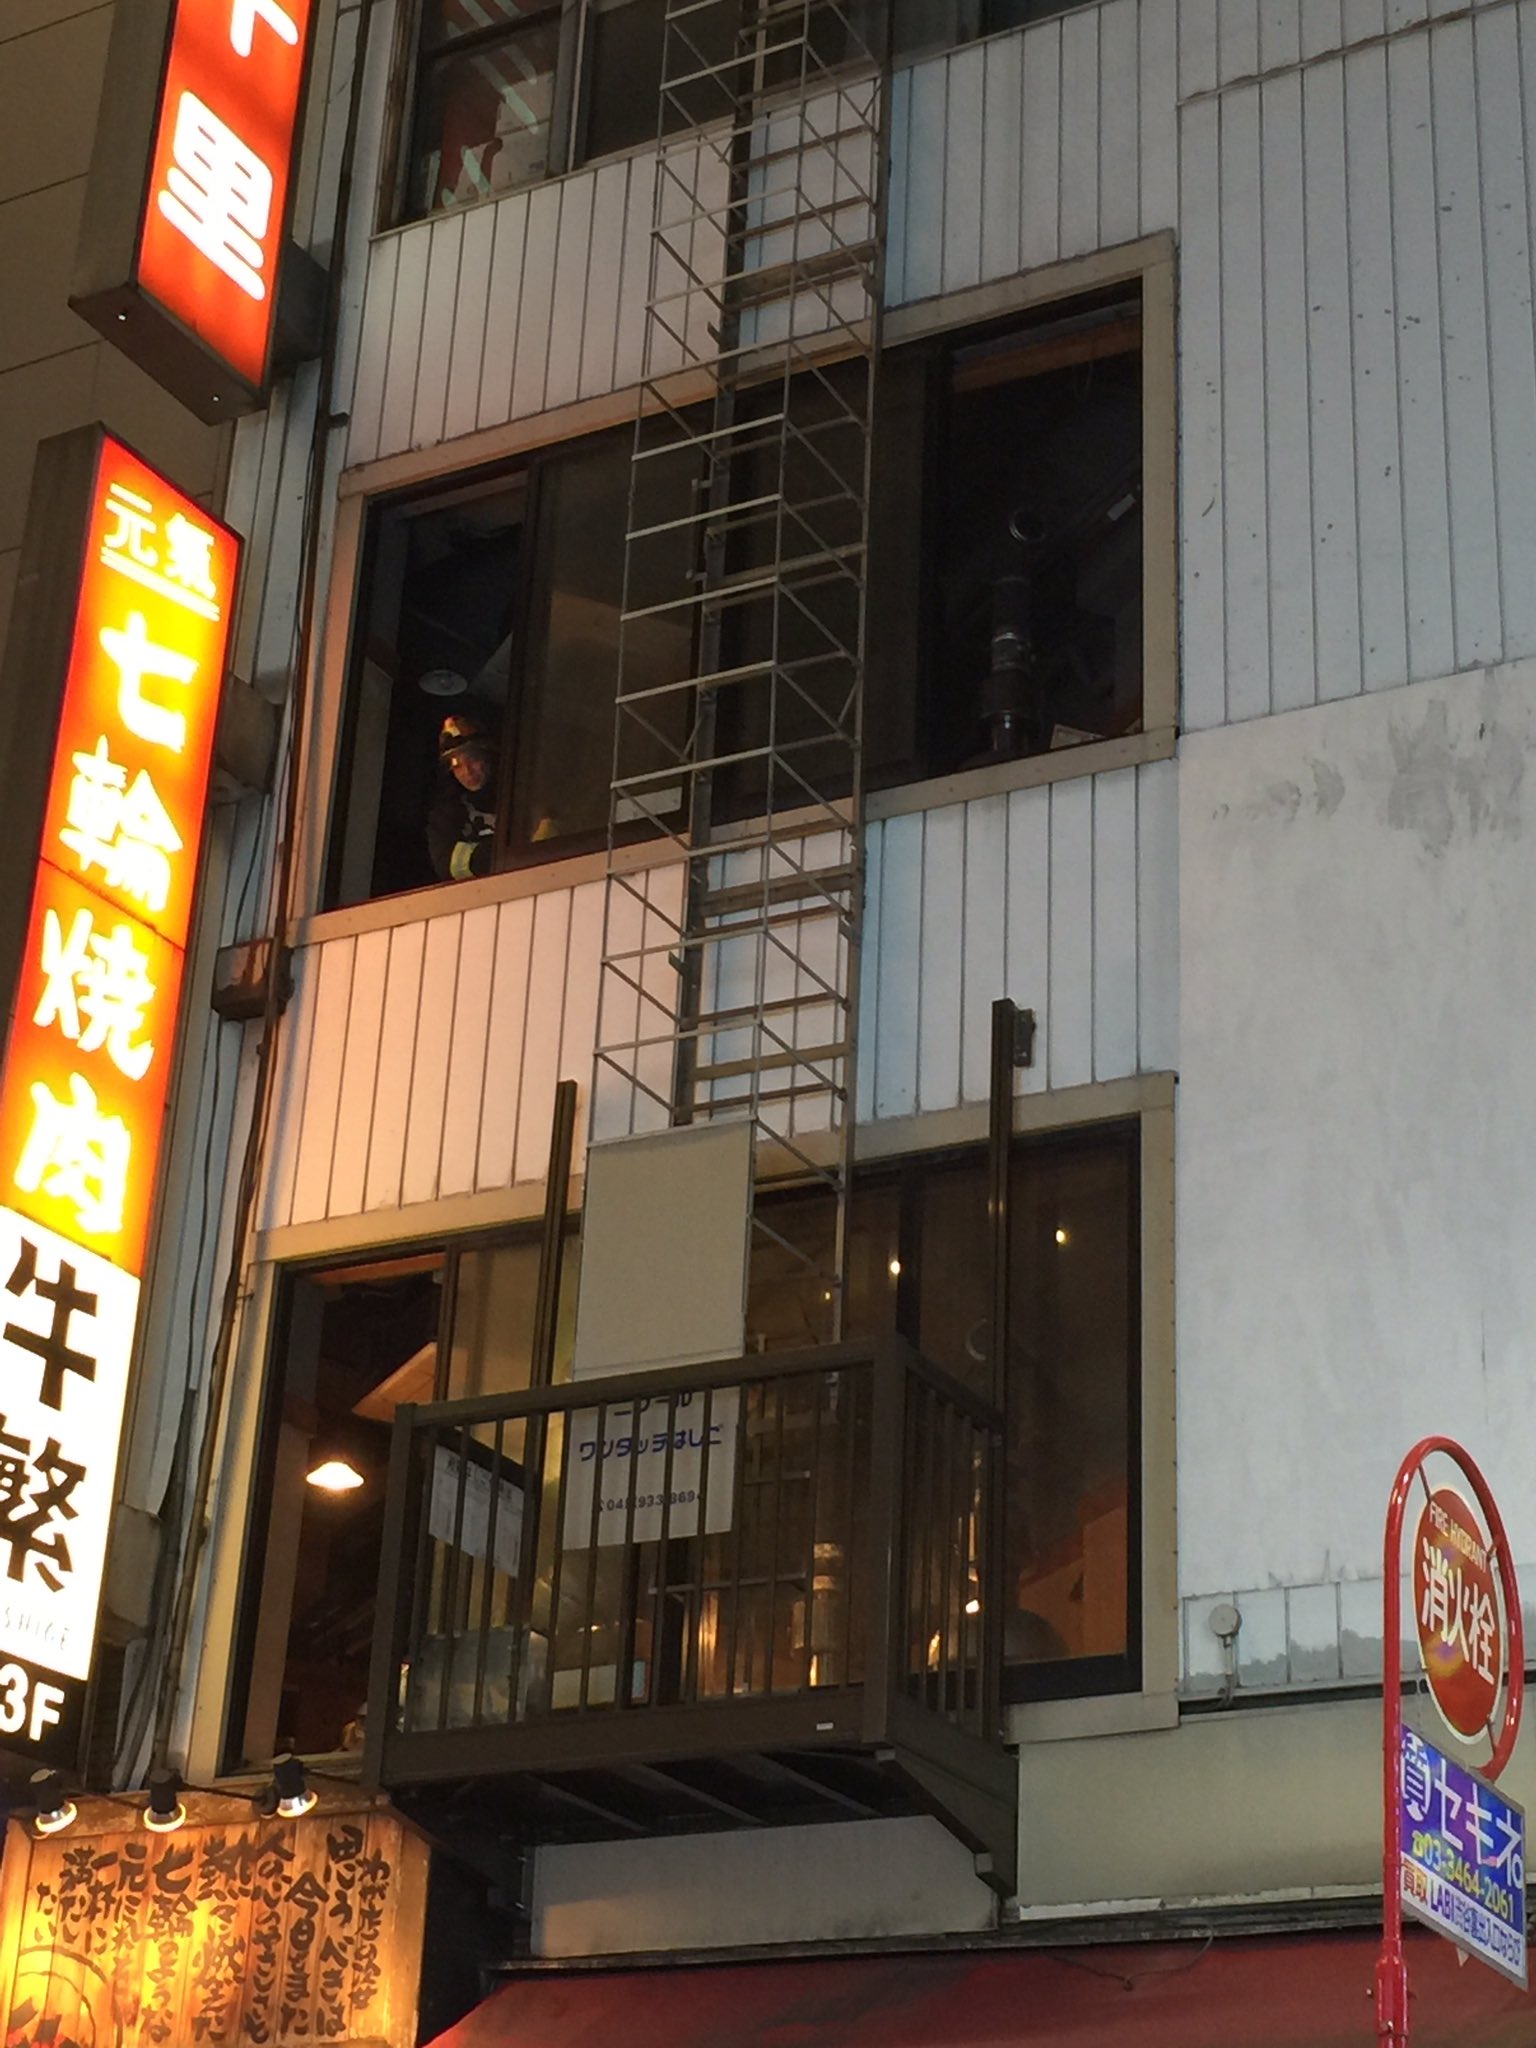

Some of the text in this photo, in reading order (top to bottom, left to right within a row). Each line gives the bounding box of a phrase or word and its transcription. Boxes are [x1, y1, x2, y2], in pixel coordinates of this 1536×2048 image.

[14, 609, 200, 1234] 七輪焼肉
[0, 1235, 99, 1593] 牛繁
[1429, 1500, 1488, 1574] FIRE HYDRANT
[1421, 1536, 1496, 1686] 消火栓
[0, 1662, 66, 1742] 3F
[1424, 1833, 1515, 1923] 03-3464-2061
[1434, 1757, 1524, 1890] セキネ
